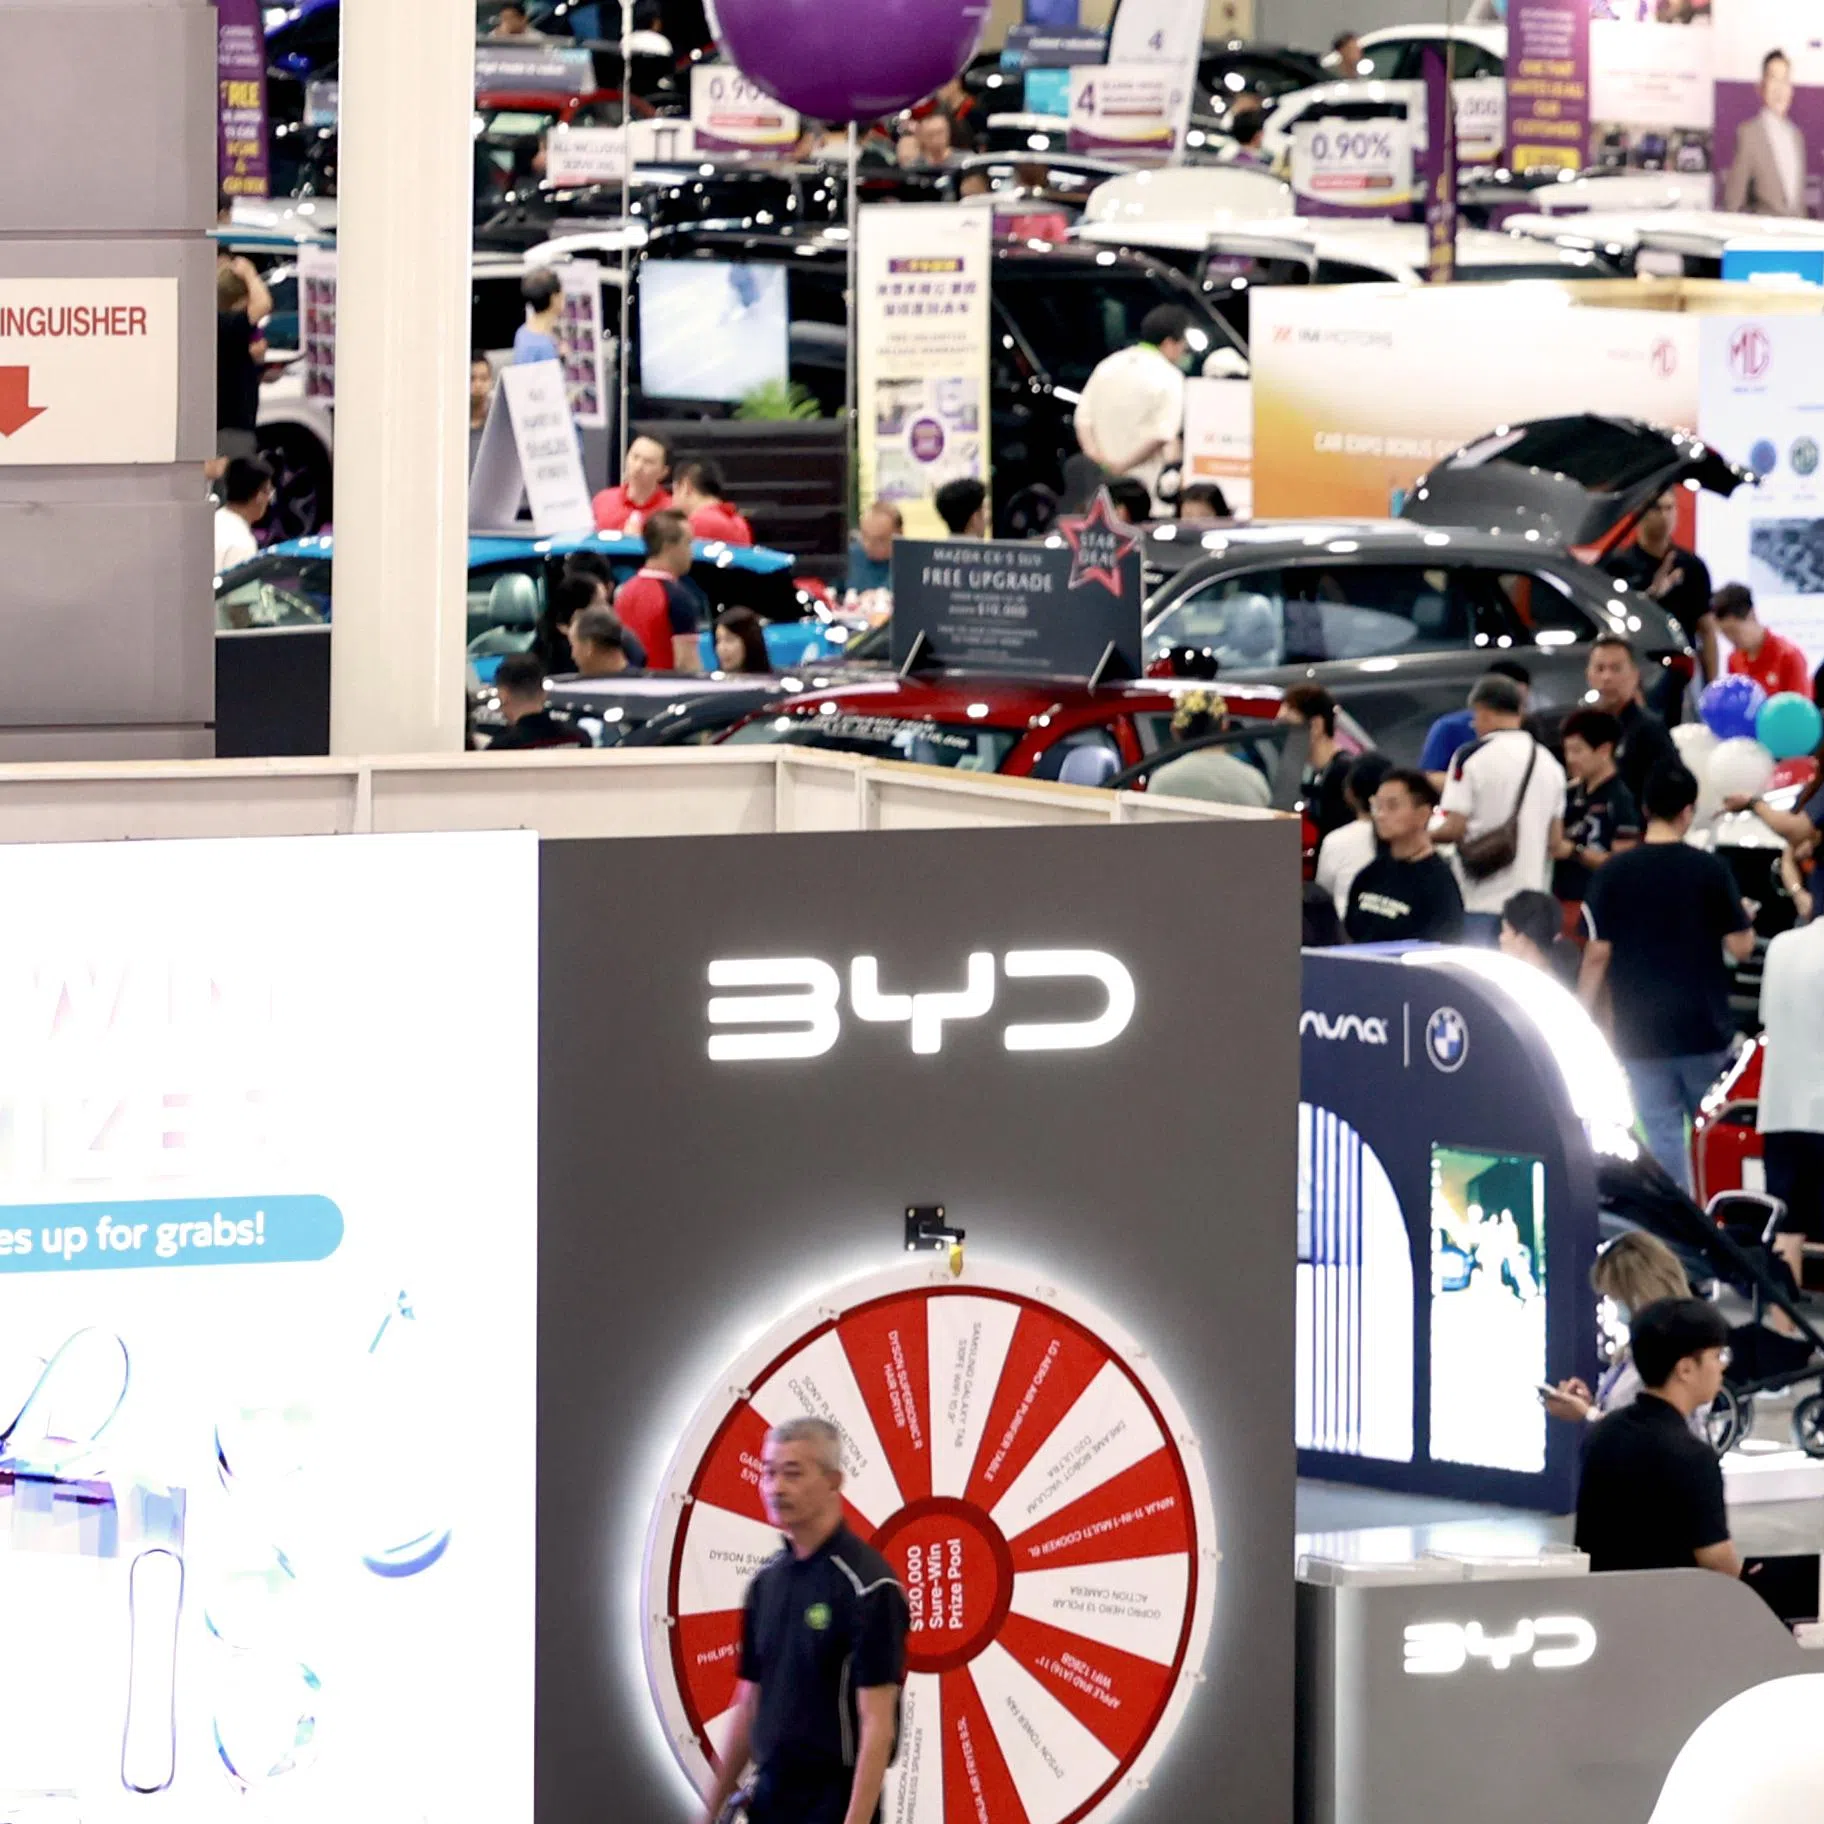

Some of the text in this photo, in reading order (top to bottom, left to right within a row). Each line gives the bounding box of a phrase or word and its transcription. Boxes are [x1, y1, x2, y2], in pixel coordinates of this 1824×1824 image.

[1312, 131, 1391, 160] 0.90%
[0, 306, 147, 337] INGUISHER
[922, 566, 1054, 594] FREE UPGRADE
[708, 949, 1137, 1062] BYD
[42, 1211, 266, 1259] up for grabs!
[888, 1329, 902, 1371] DYSON
[801, 1375, 822, 1403] SONY
[1026, 1477, 1066, 1515] VACUUM
[1144, 1496, 1177, 1516] NINJA
[708, 1549, 744, 1564] DYSON
[1041, 1528, 1083, 1555] COOKER
[906, 1543, 926, 1633] $120,000
[926, 1543, 944, 1631] Sure-Win
[946, 1537, 964, 1631] Prize Pool
[1068, 1585, 1111, 1600] CAMERA
[696, 1643, 735, 1666] PHILIPS
[1403, 1614, 1598, 1675] BYD
[1005, 1695, 1020, 1718] FAN
[1017, 1714, 1042, 1750] TOWER
